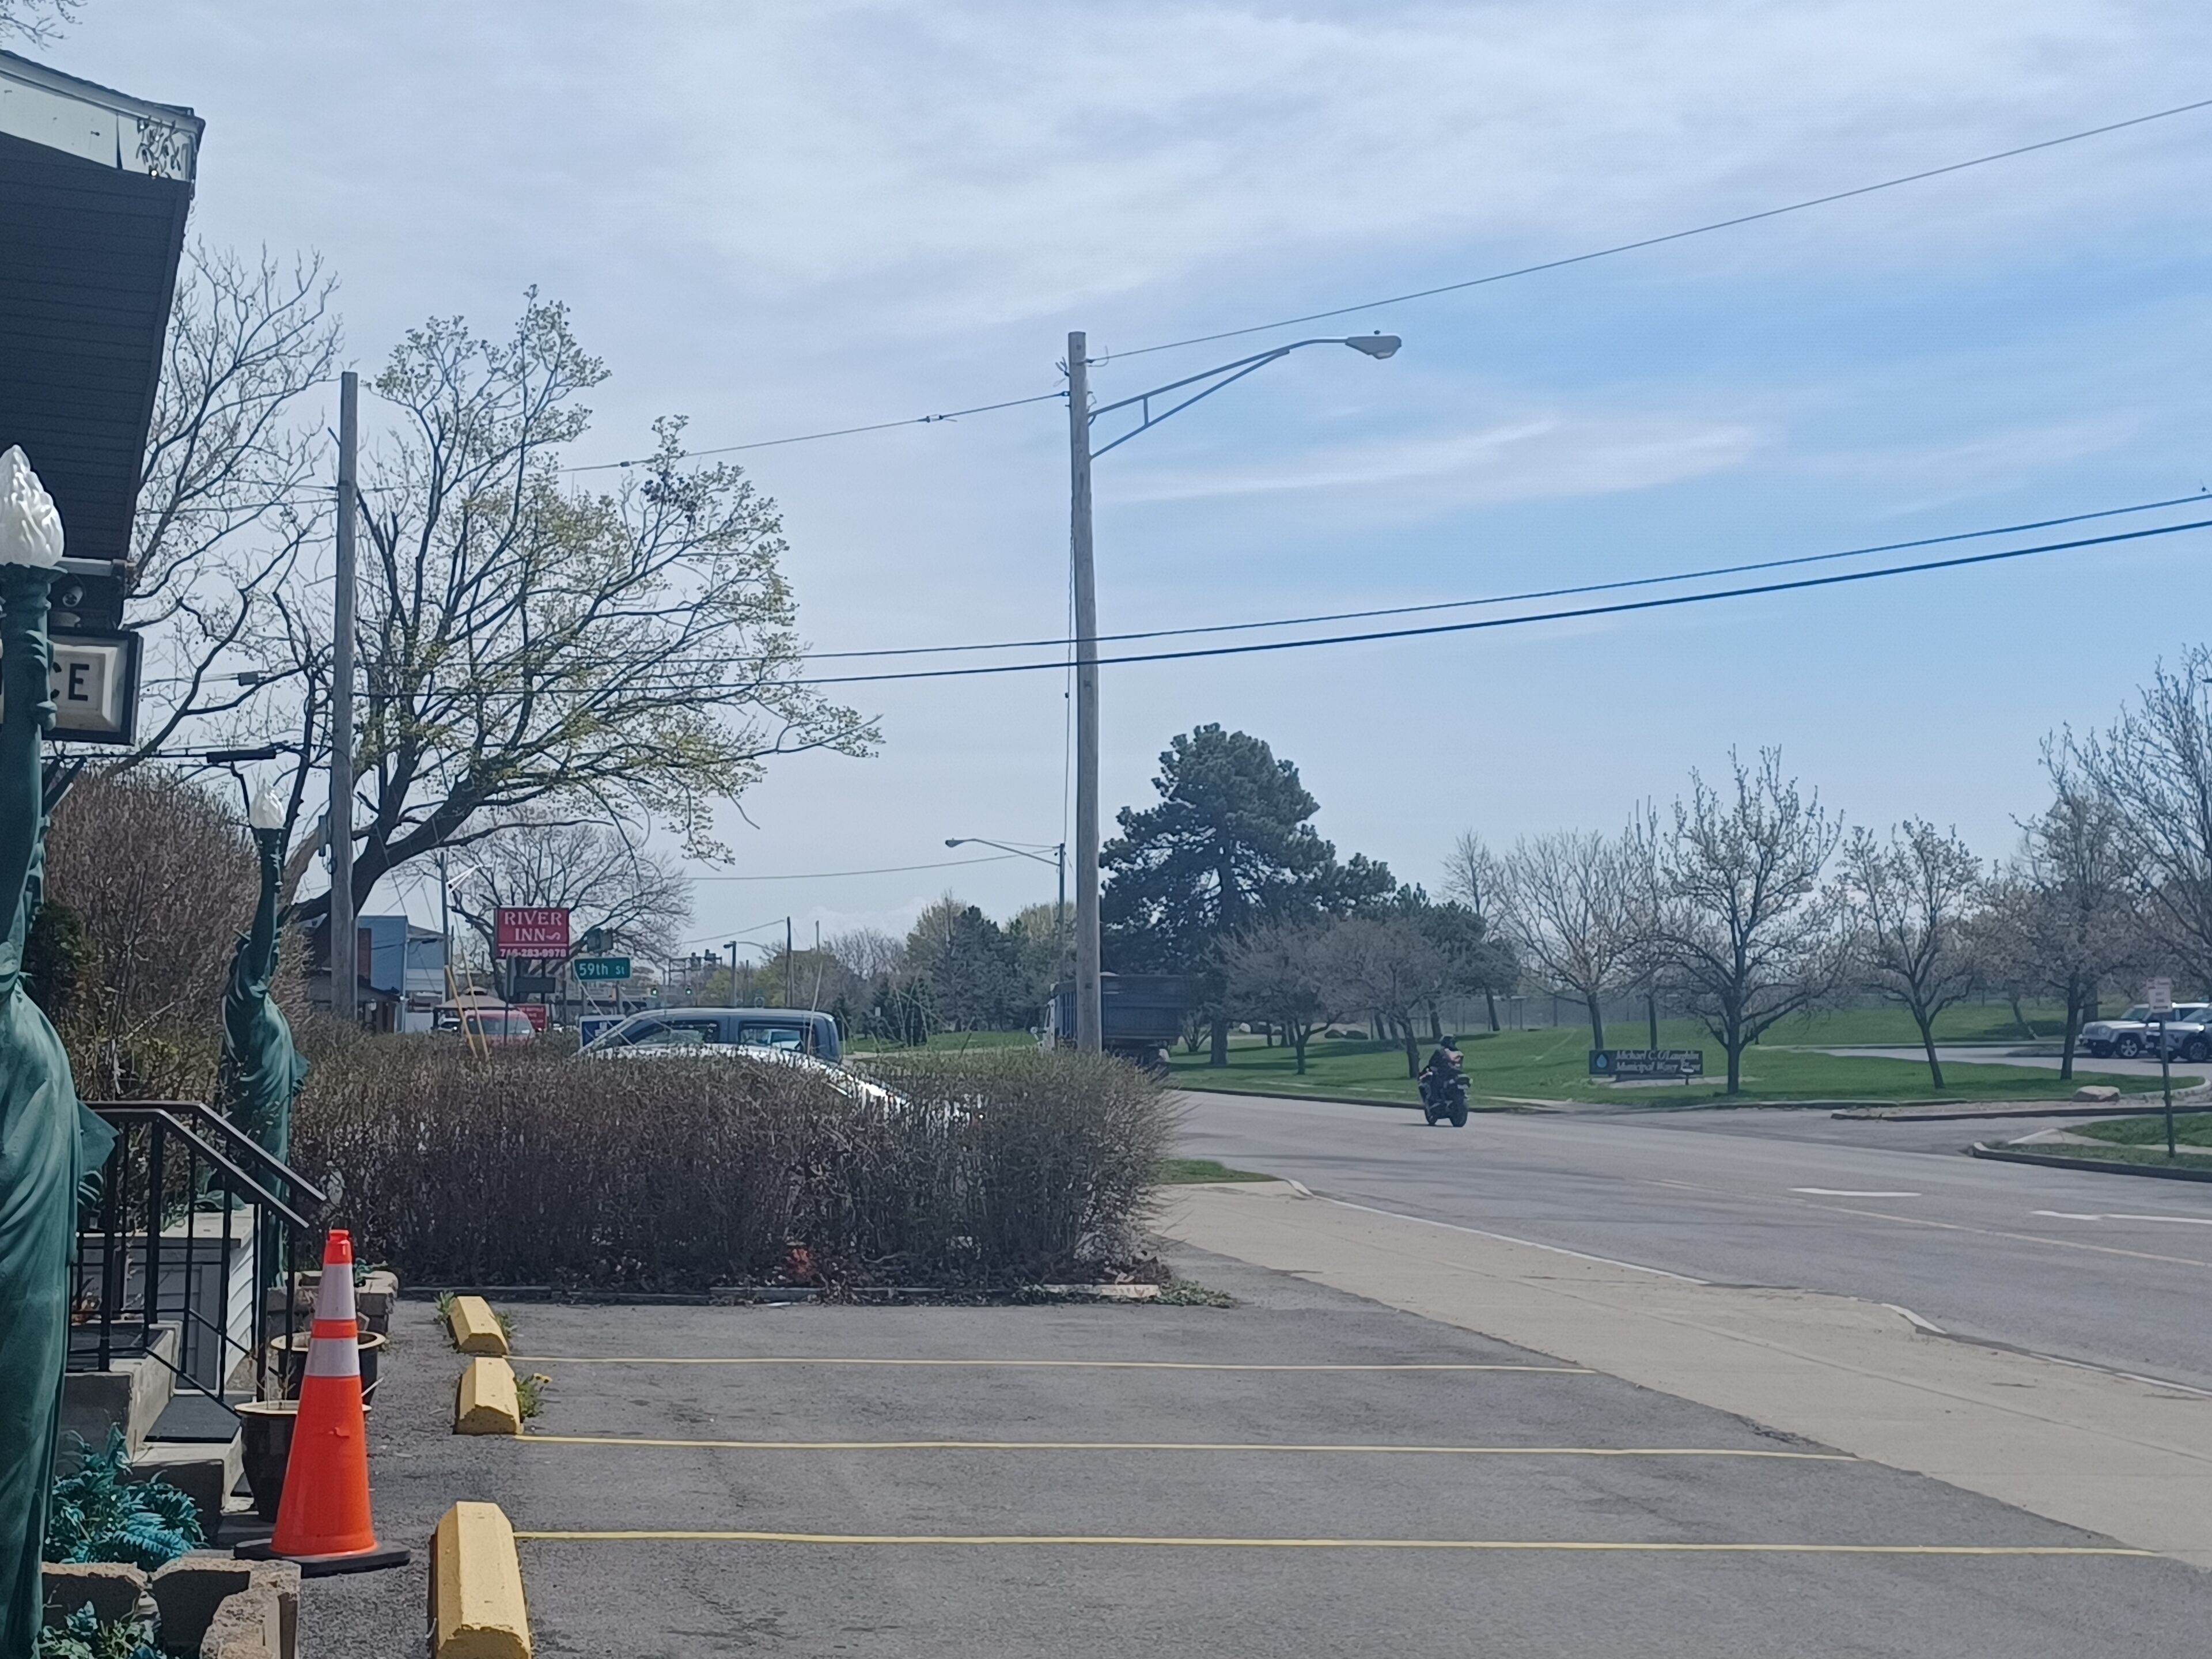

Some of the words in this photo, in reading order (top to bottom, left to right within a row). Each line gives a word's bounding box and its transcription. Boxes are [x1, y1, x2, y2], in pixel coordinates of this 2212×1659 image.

[504, 910, 562, 926] RIVER
[514, 928, 546, 942] INN
[579, 963, 608, 976] 59th
